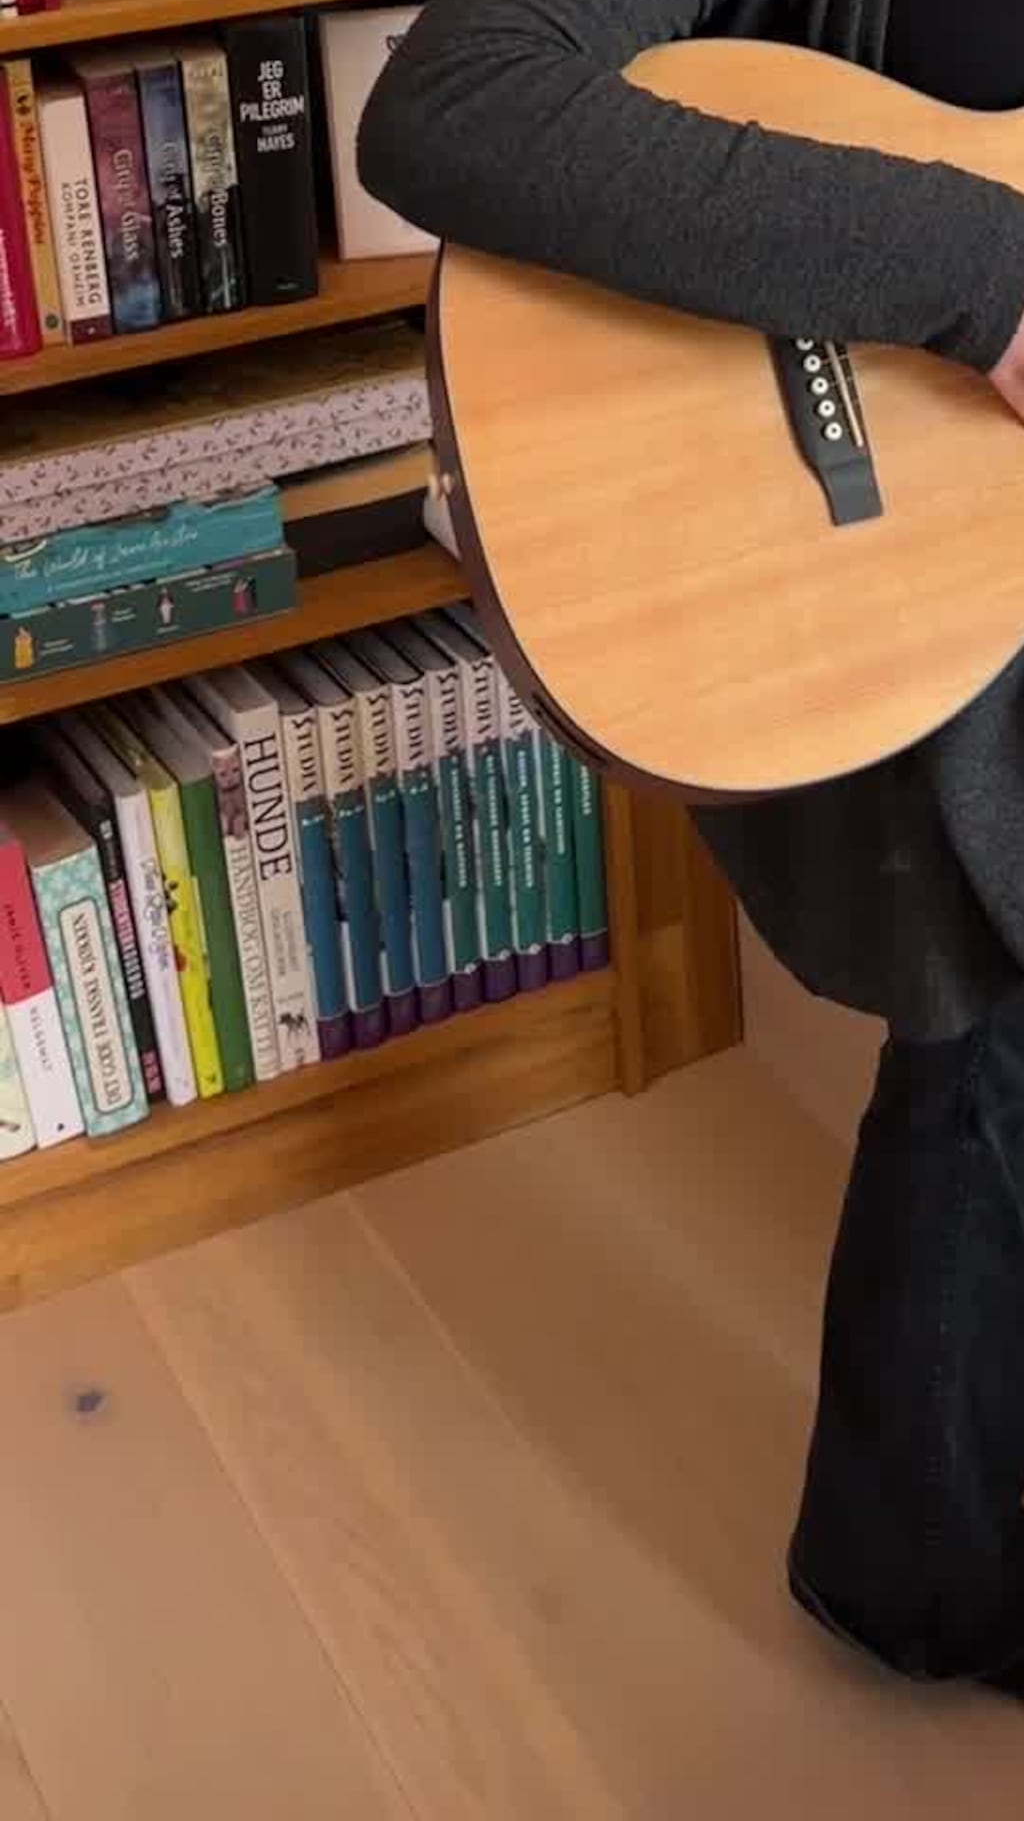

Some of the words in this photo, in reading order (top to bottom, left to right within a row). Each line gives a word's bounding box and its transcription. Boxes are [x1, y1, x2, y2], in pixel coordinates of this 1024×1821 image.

[258, 60, 284, 81] JEG
[262, 79, 282, 100] ER
[240, 95, 304, 122] PILEGRIM
[112, 148, 133, 188] City
[256, 133, 295, 152] HAYES
[26, 171, 45, 245] Poppins
[60, 182, 80, 247] KOMPANI
[73, 177, 93, 219] TORE
[212, 189, 230, 248] Bones
[119, 209, 140, 260] Glass
[165, 200, 185, 259] Ashes
[69, 254, 88, 308] ORHEIM
[80, 227, 103, 304] RENBERG
[13, 559, 37, 580] The
[437, 670, 459, 758] STUDIA
[472, 656, 493, 737] STUDIA
[292, 716, 317, 795] STUDIA
[333, 708, 355, 786] STUDIA
[403, 686, 425, 770] STUDIA
[244, 733, 292, 881] HUNDE
